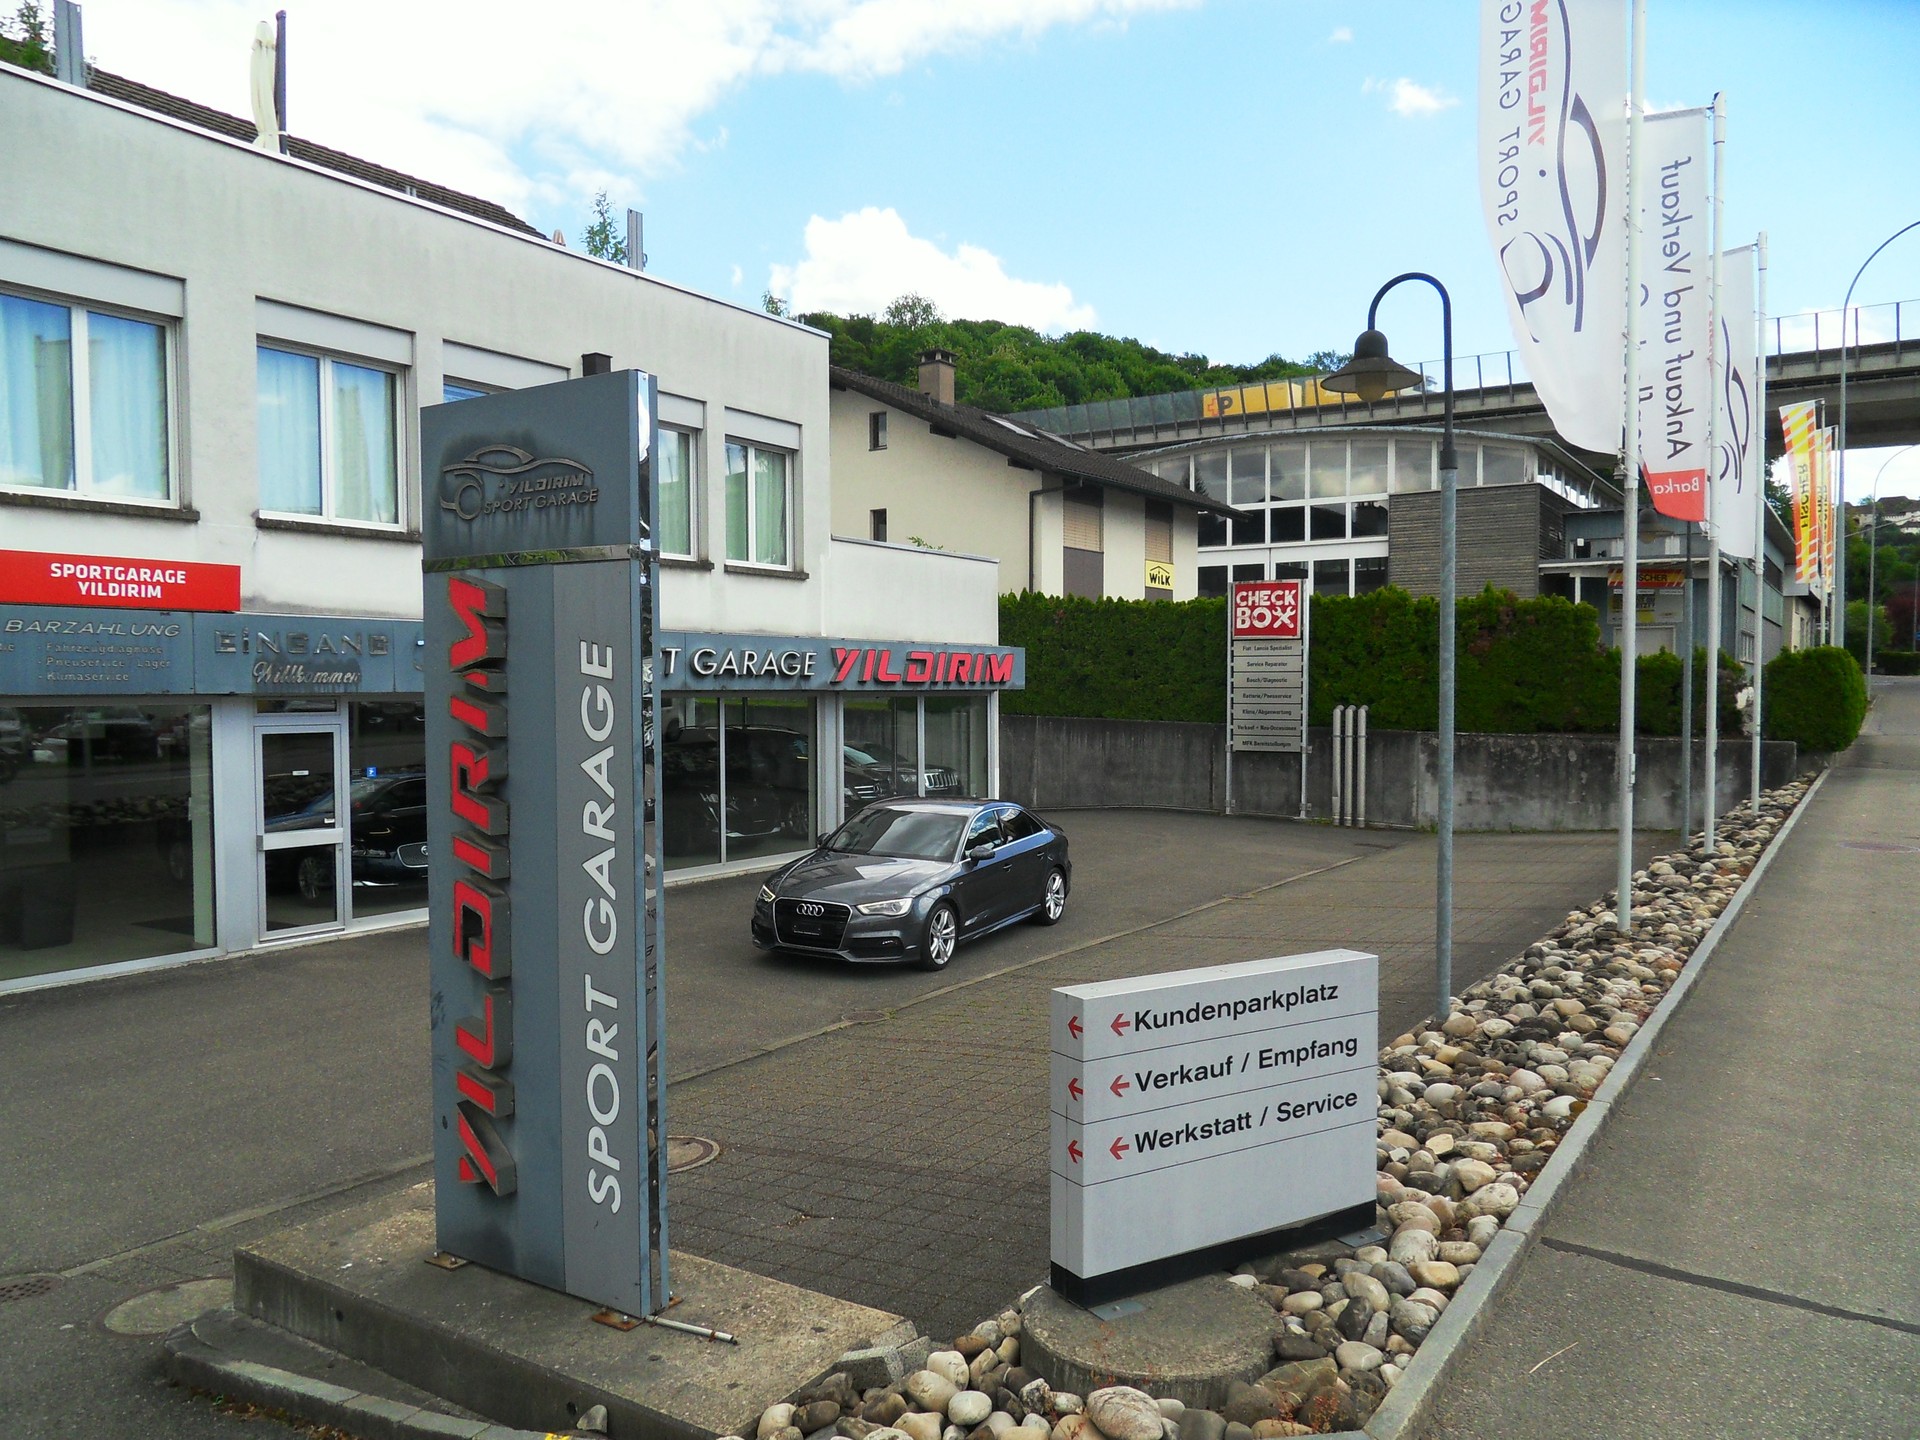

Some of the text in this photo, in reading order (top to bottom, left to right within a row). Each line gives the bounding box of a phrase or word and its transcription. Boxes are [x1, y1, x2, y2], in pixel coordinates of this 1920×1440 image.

[508, 473, 585, 496] YILDIRIM
[483, 487, 599, 515] SPORT GARAGE
[50, 562, 187, 585] SPORTGARAGE
[1638, 573, 1668, 582] SCHER
[78, 581, 162, 599] YILDIRIM
[1235, 589, 1297, 607] CHECK
[5, 619, 182, 637] BARZAHLUNG
[252, 661, 361, 684] Willkommen
[692, 647, 818, 677] GARAGE
[831, 646, 1015, 684] YILDIRIM
[449, 574, 505, 1193] YILDIRIM
[579, 637, 622, 1215] SPORT GARAGE
[1133, 983, 1339, 1033] Kundenparkplatz
[1134, 1036, 1359, 1093] Verkauf / Empfang
[1134, 1091, 1359, 1154] Werkstatt / Service
